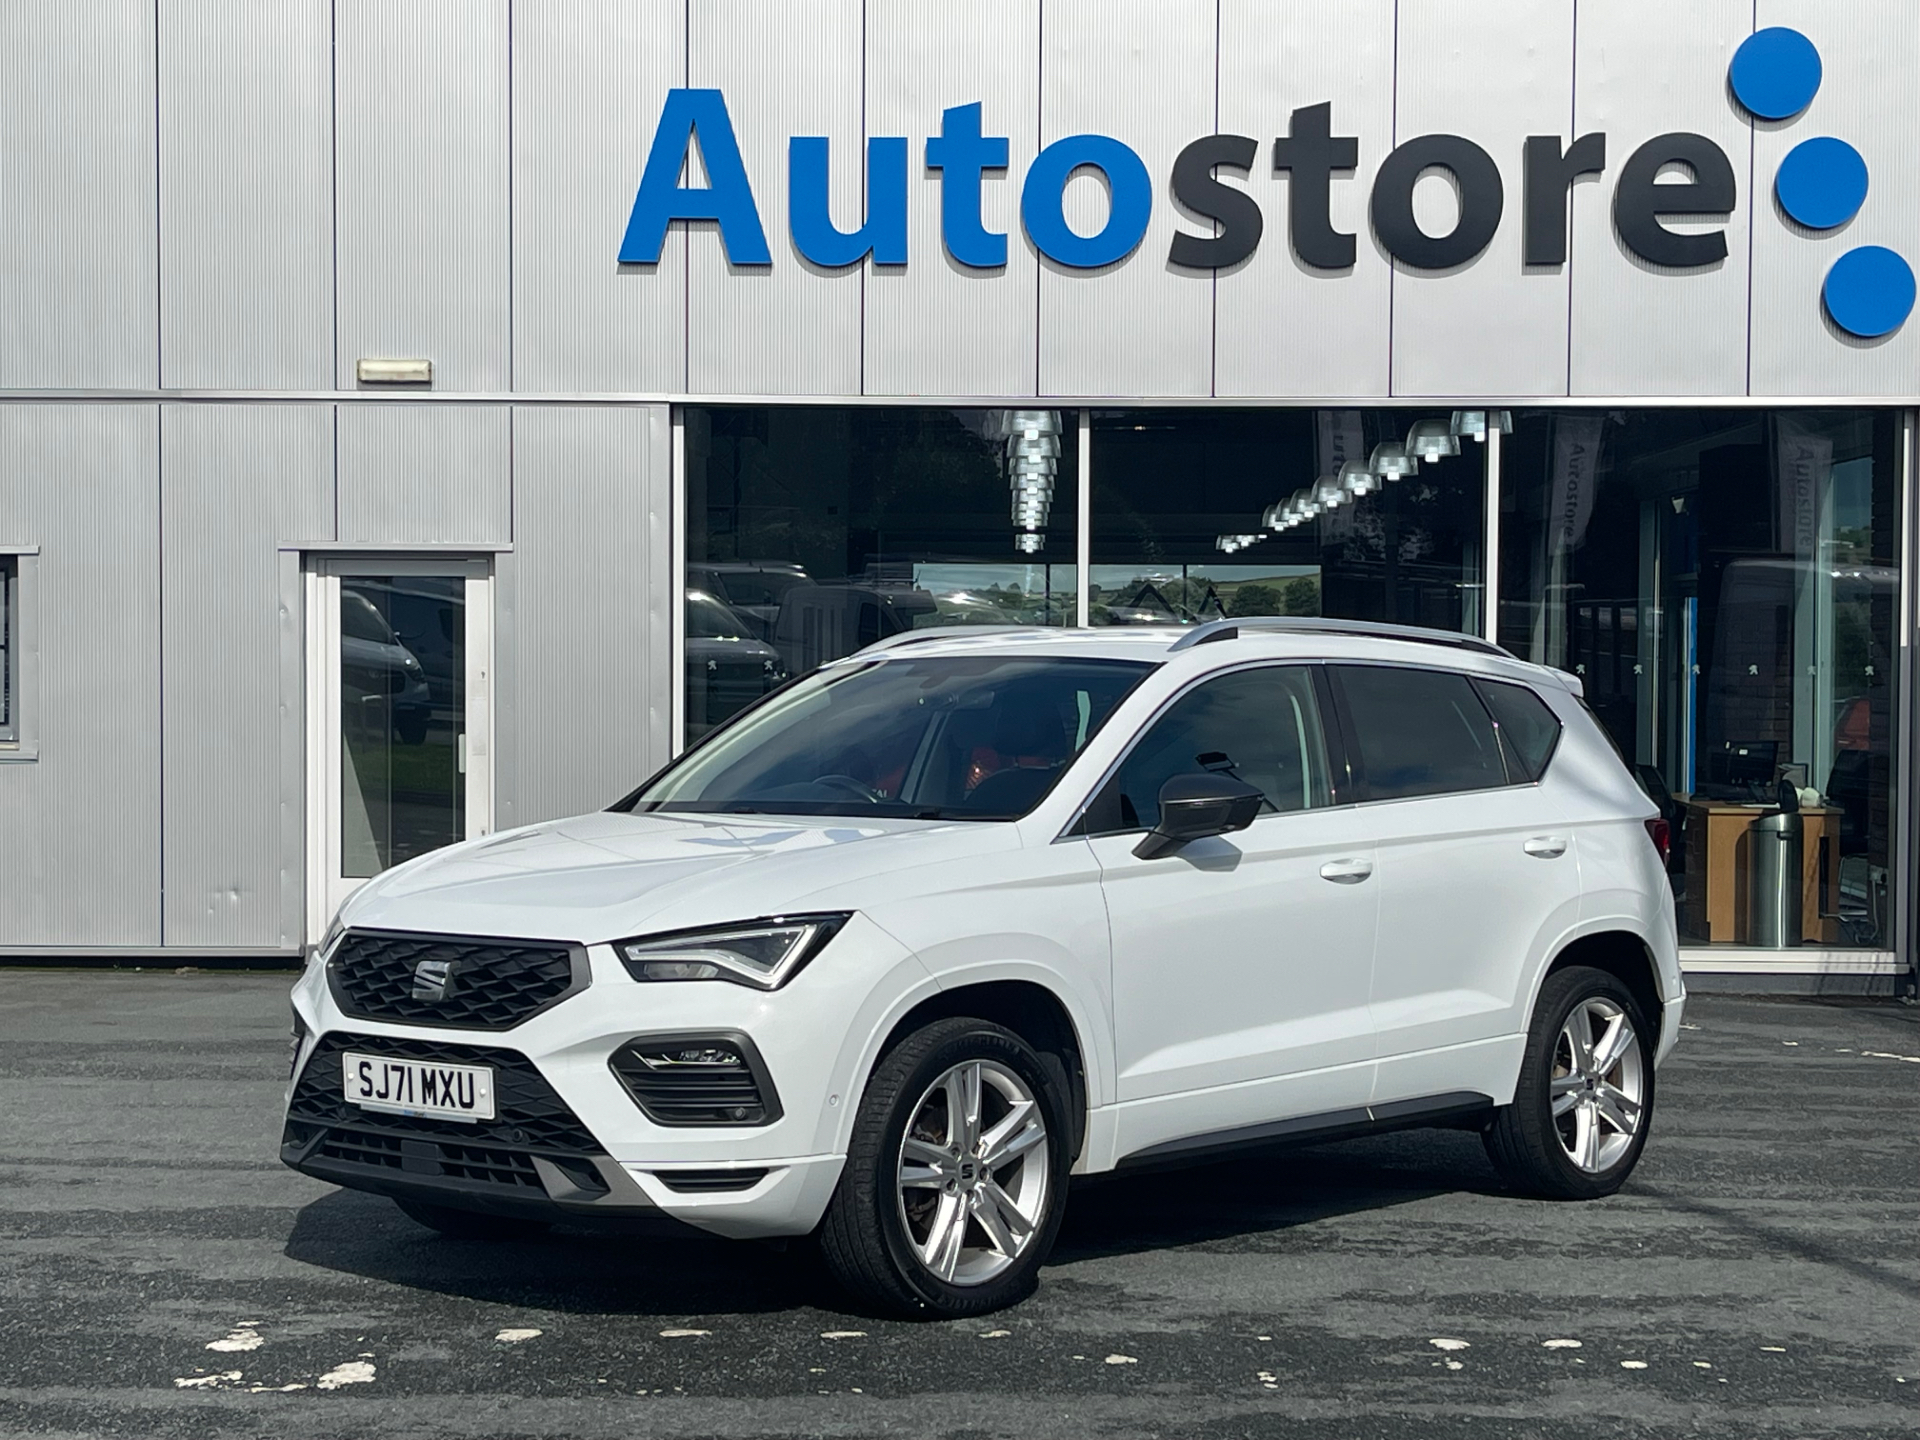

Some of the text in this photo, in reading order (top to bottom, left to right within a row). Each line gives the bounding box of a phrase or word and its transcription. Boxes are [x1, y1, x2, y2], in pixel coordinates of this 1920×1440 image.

[617, 88, 1737, 269] Autostore
[1564, 443, 1586, 538] Autostore
[1796, 445, 1815, 547] Autostore
[359, 1061, 475, 1109] SJ71 MXU
